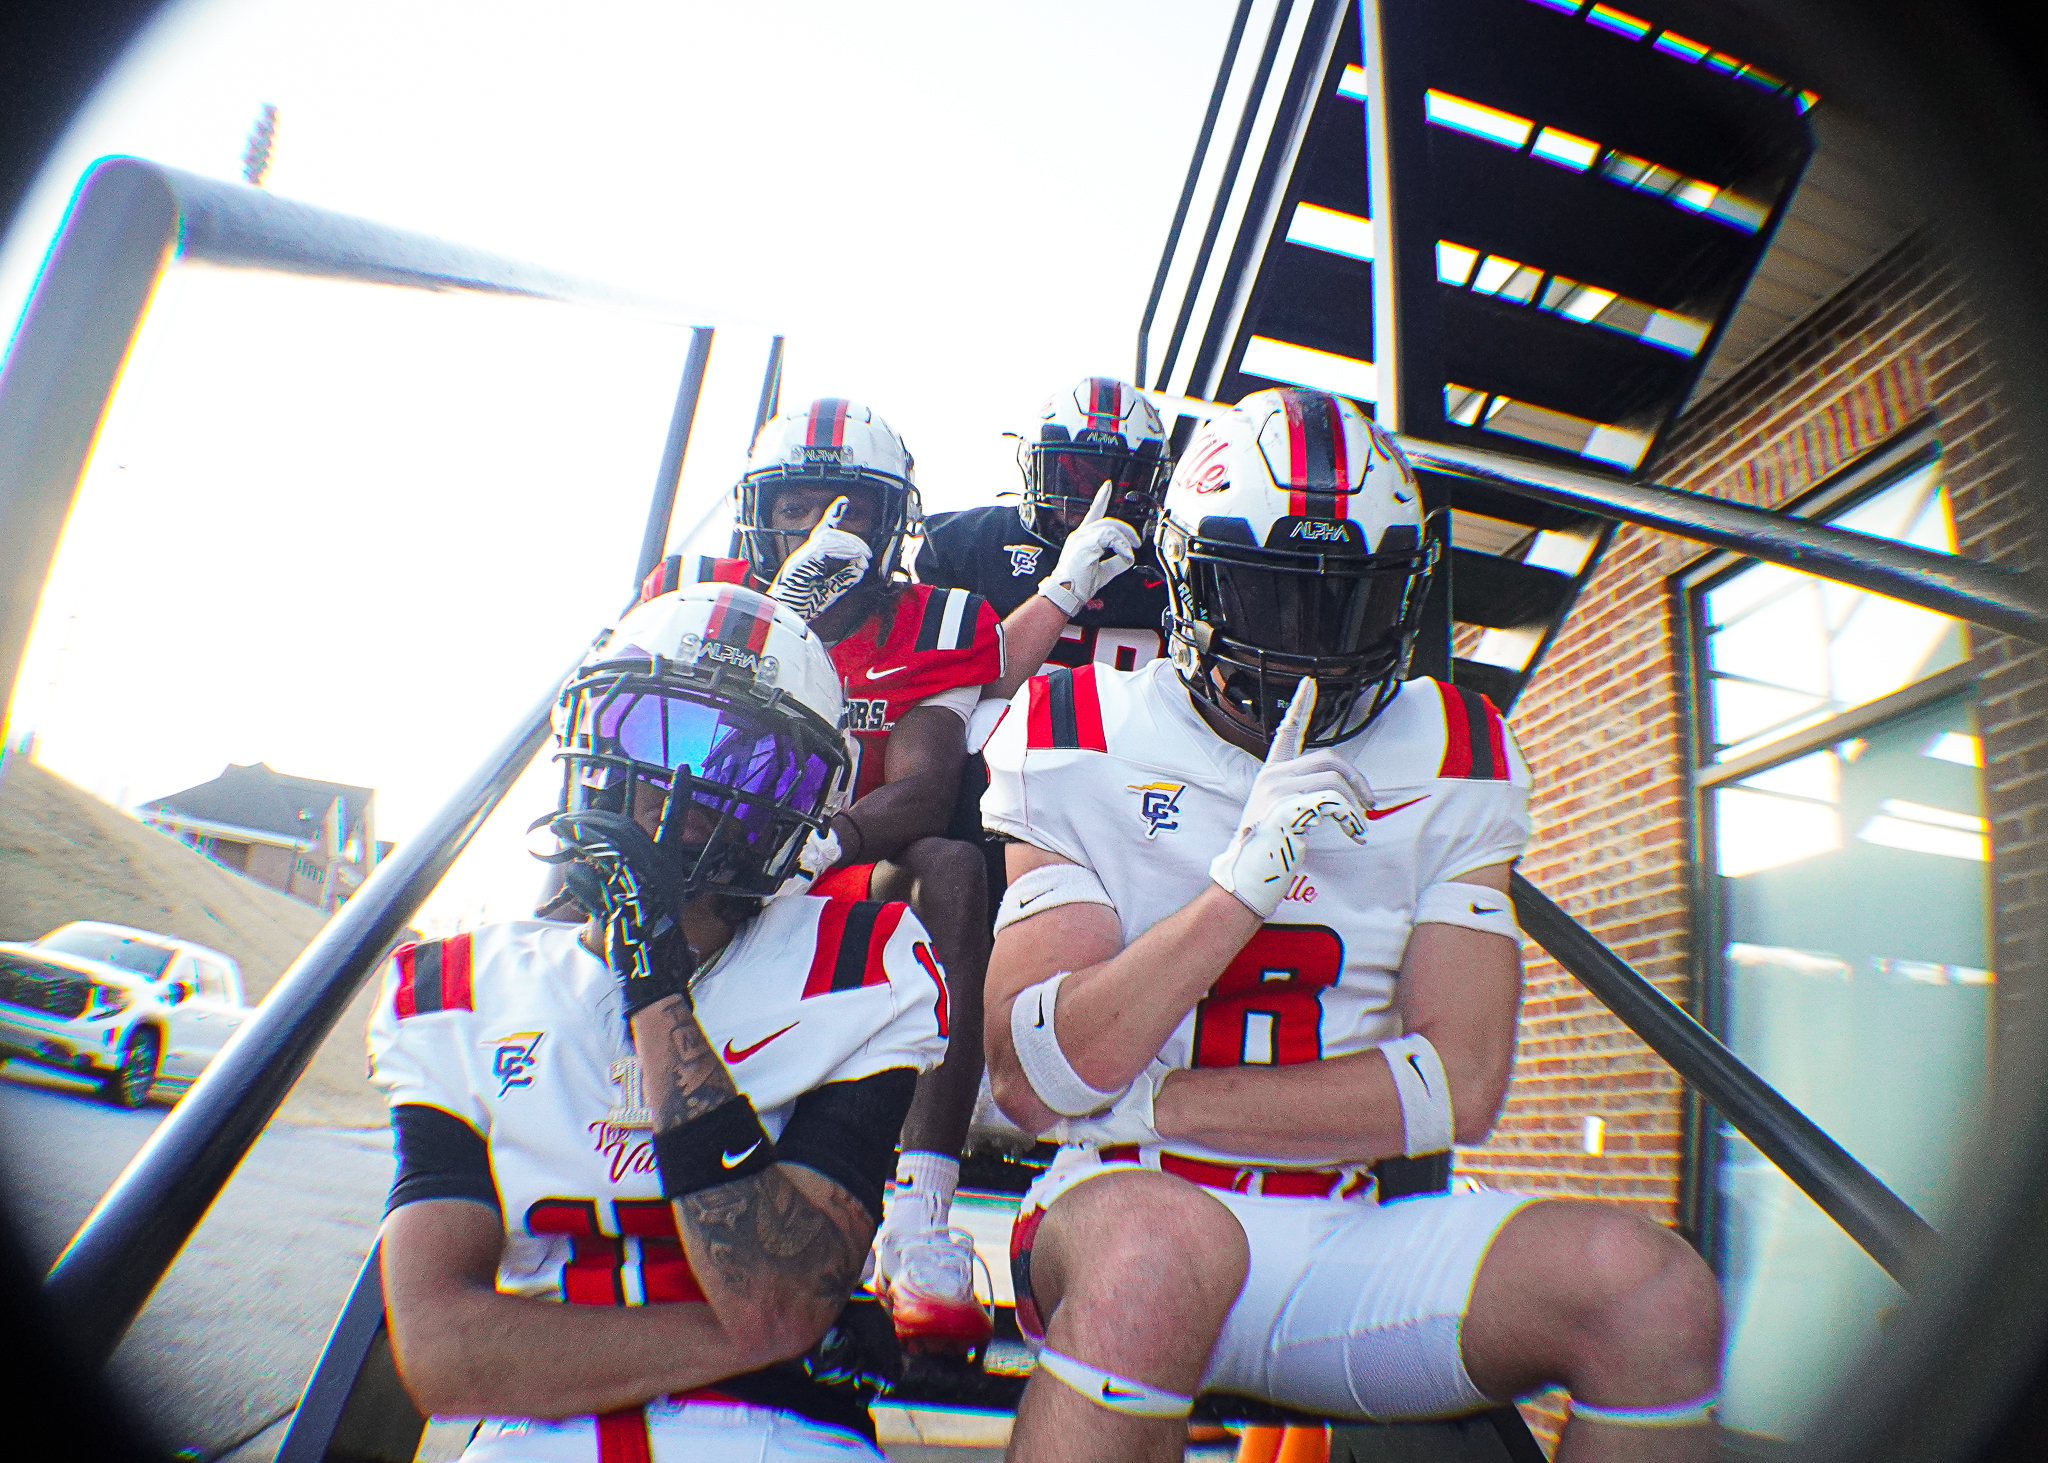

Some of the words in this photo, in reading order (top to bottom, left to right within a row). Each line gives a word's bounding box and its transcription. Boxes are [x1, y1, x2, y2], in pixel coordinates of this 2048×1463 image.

[1290, 521, 1350, 541] ALPHA
[699, 642, 759, 673] ALPHA
[1283, 875, 1318, 903] lle
[604, 1140, 659, 1183] Vil
